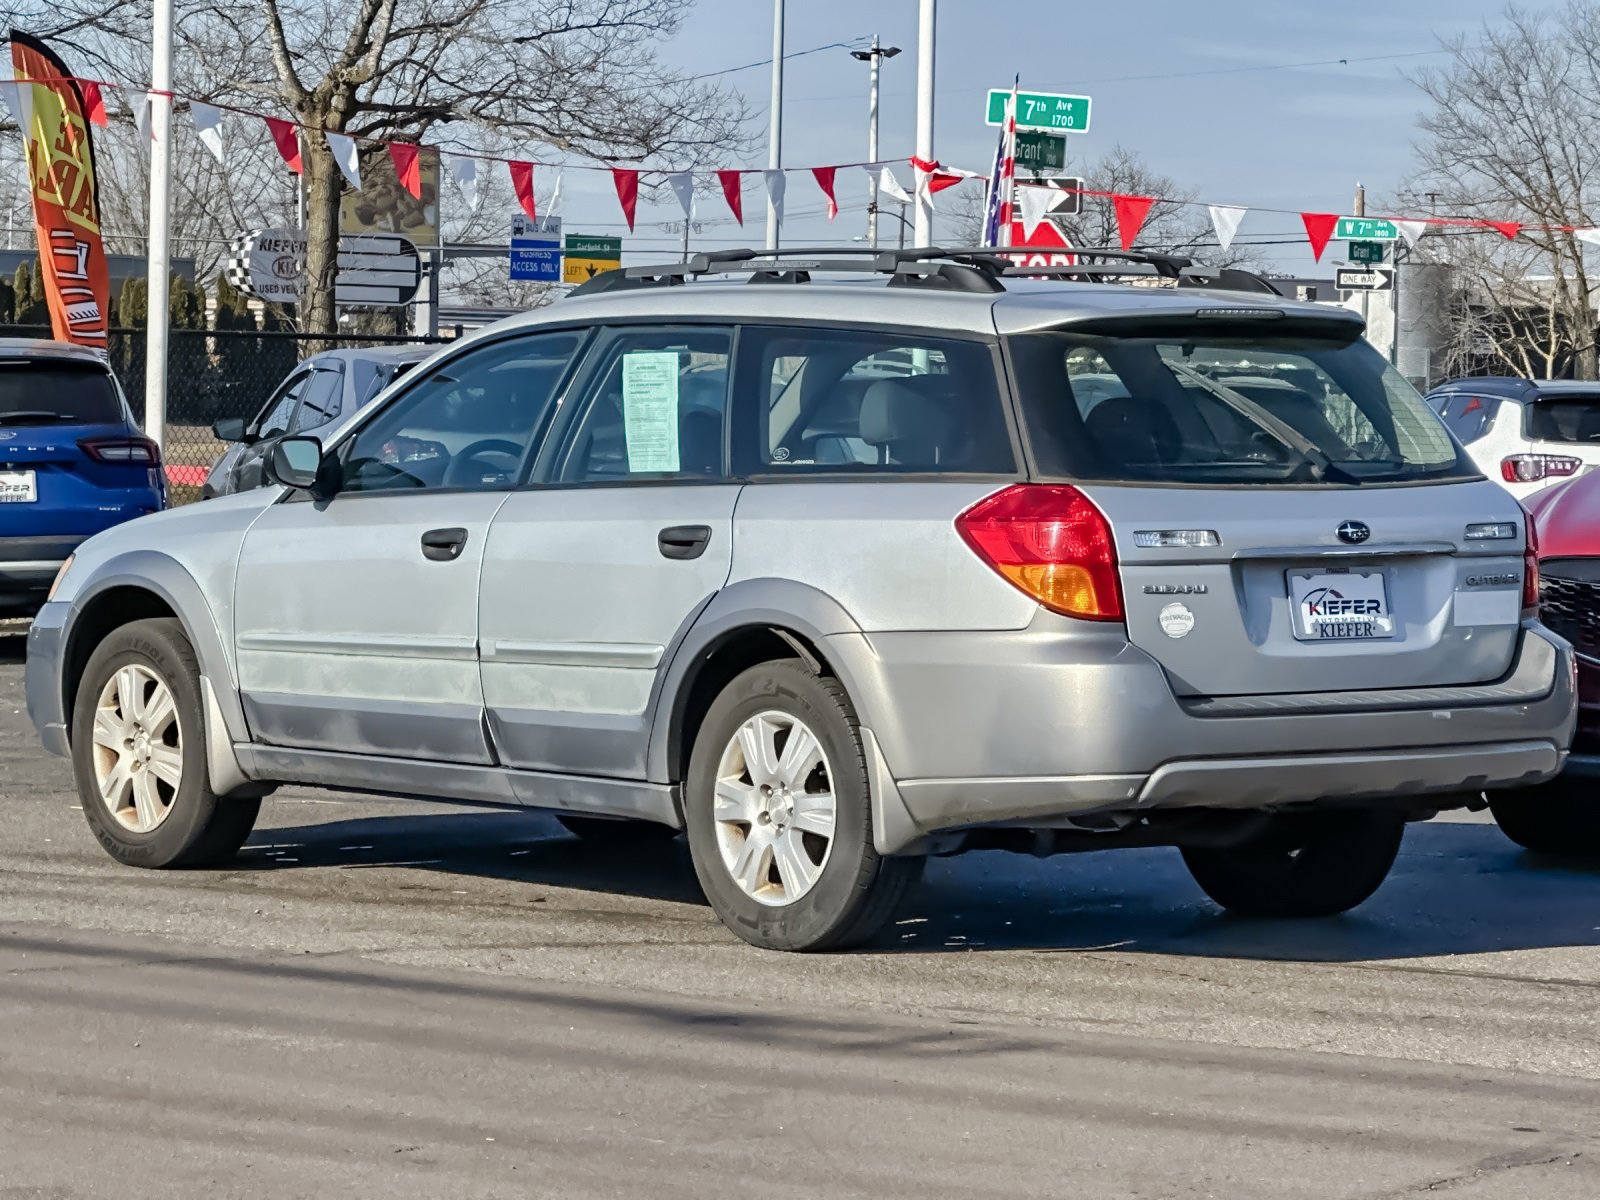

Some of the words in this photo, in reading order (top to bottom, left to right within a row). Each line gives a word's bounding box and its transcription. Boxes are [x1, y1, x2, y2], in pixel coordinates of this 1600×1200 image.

[1025, 100, 1047, 121] 7th
[1055, 100, 1073, 111] Ave
[1051, 115, 1074, 126] 1700
[1014, 138, 1042, 160] Grant
[525, 223, 539, 233] BUS
[1345, 221, 1354, 235] W
[511, 262, 538, 272] ACCESS
[540, 262, 559, 273] ONLY
[566, 265, 582, 276] LEFT
[1342, 275, 1358, 284] ONE
[1360, 275, 1377, 284] WAY
[259, 284, 280, 294] USED
[1143, 585, 1208, 595] SUBARU
[1309, 600, 1382, 616] KIEFER
[1319, 622, 1374, 638] KIEFER
